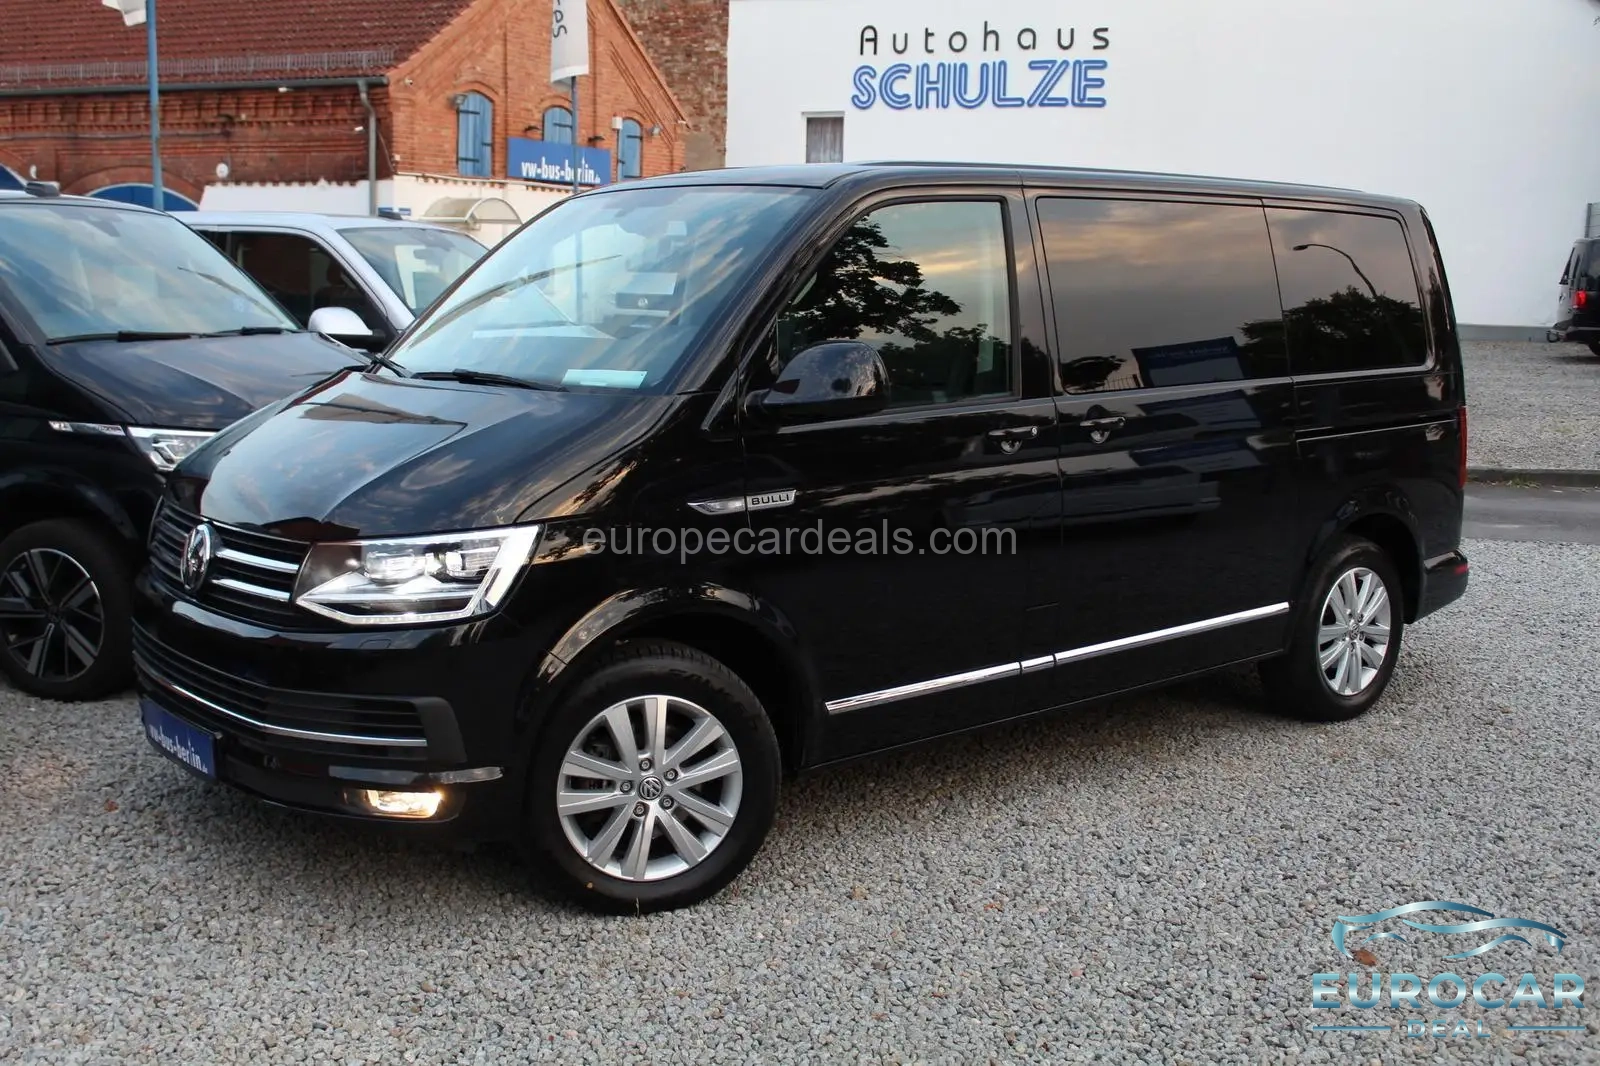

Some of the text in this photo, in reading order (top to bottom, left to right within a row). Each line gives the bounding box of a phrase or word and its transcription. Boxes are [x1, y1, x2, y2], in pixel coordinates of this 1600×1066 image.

[860, 20, 1110, 55] Autohaus
[851, 60, 1109, 110] SCHULZE
[751, 493, 789, 506] BULLI
